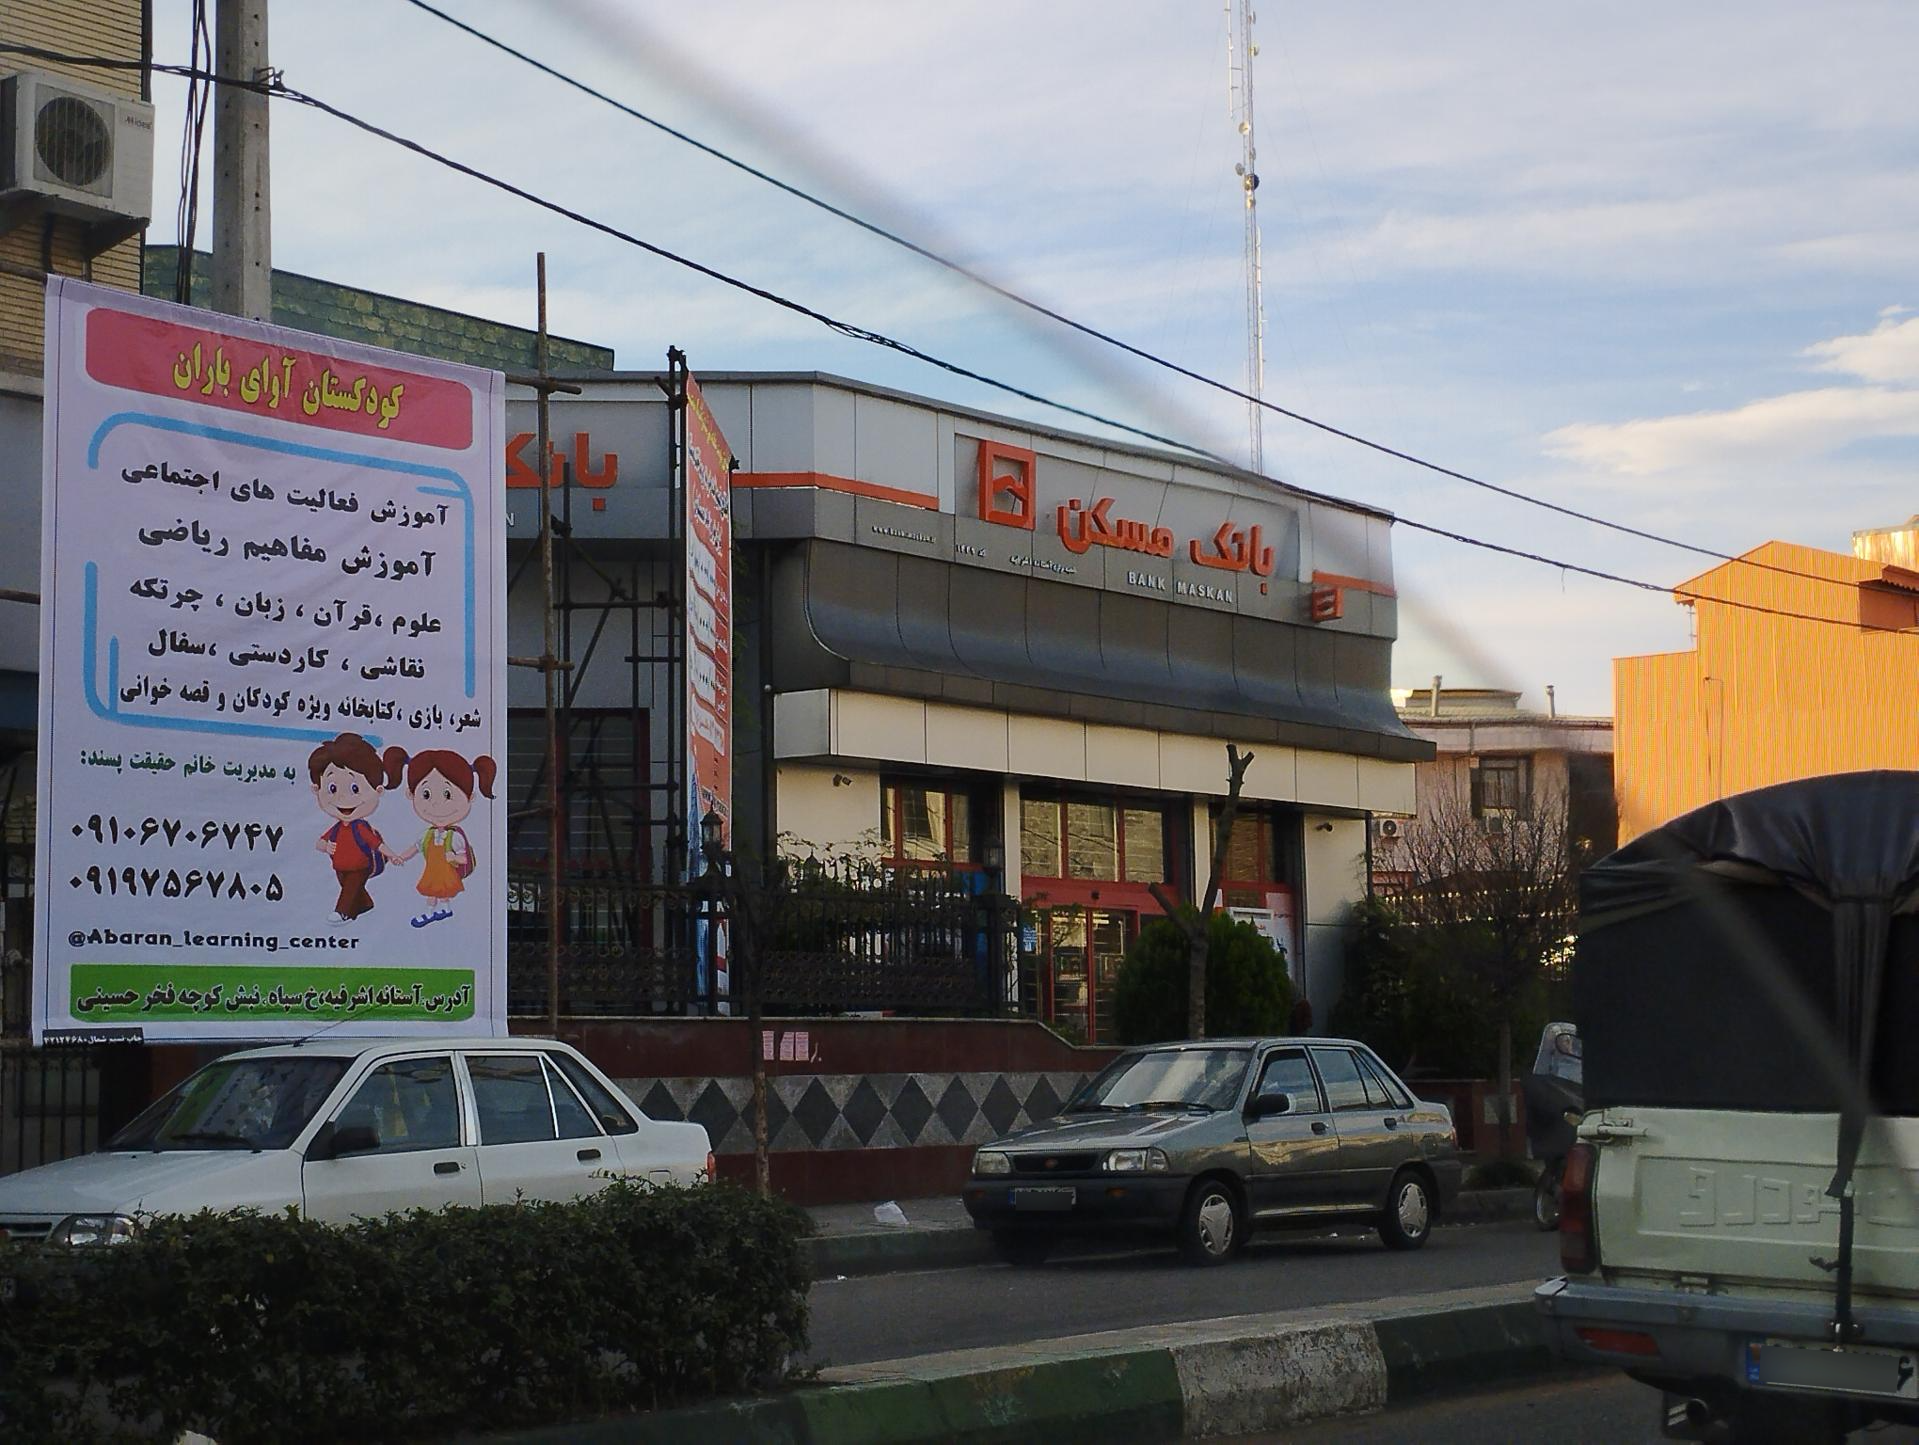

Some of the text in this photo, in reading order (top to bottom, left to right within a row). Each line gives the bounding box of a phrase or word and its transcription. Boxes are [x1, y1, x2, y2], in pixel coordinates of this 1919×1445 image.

[172, 343, 404, 429] کودکستان آوای باران
[121, 462, 449, 527] آموزش فعالیت های اجتماعی
[138, 520, 436, 580] آموزش مفاهیم ریاضی
[1056, 497, 1276, 596] بانک مسکن
[130, 578, 203, 612] چرتکه
[1128, 571, 1232, 603] BANK MASKAN
[234, 597, 286, 623] زبان
[392, 608, 442, 635] علوم
[228, 646, 329, 670] کاردستی
[360, 656, 425, 682] نقاشی
[120, 677, 173, 706] خوانی
[179, 680, 210, 705] قصه
[217, 694, 226, 712] و
[232, 686, 291, 716] کودکان
[296, 693, 332, 721] ویژه
[408, 703, 443, 729] بازی
[130, 752, 177, 773] حقیقت
[182, 757, 216, 776] خانم
[223, 760, 277, 783] مدیریت
[283, 767, 296, 785] به
[71, 814, 284, 852] ۰۹۱۰۶۷۰۶۷۴۷
[69, 865, 283, 901] ۰۹۱۹۷۵۶۷۸۰۵
[68, 929, 360, 952] @Abaran_learning_center
[77, 987, 139, 1012] حسینی
[141, 982, 176, 1011] فخر
[179, 983, 223, 1012] کوچه
[225, 984, 260, 1011] نبش
